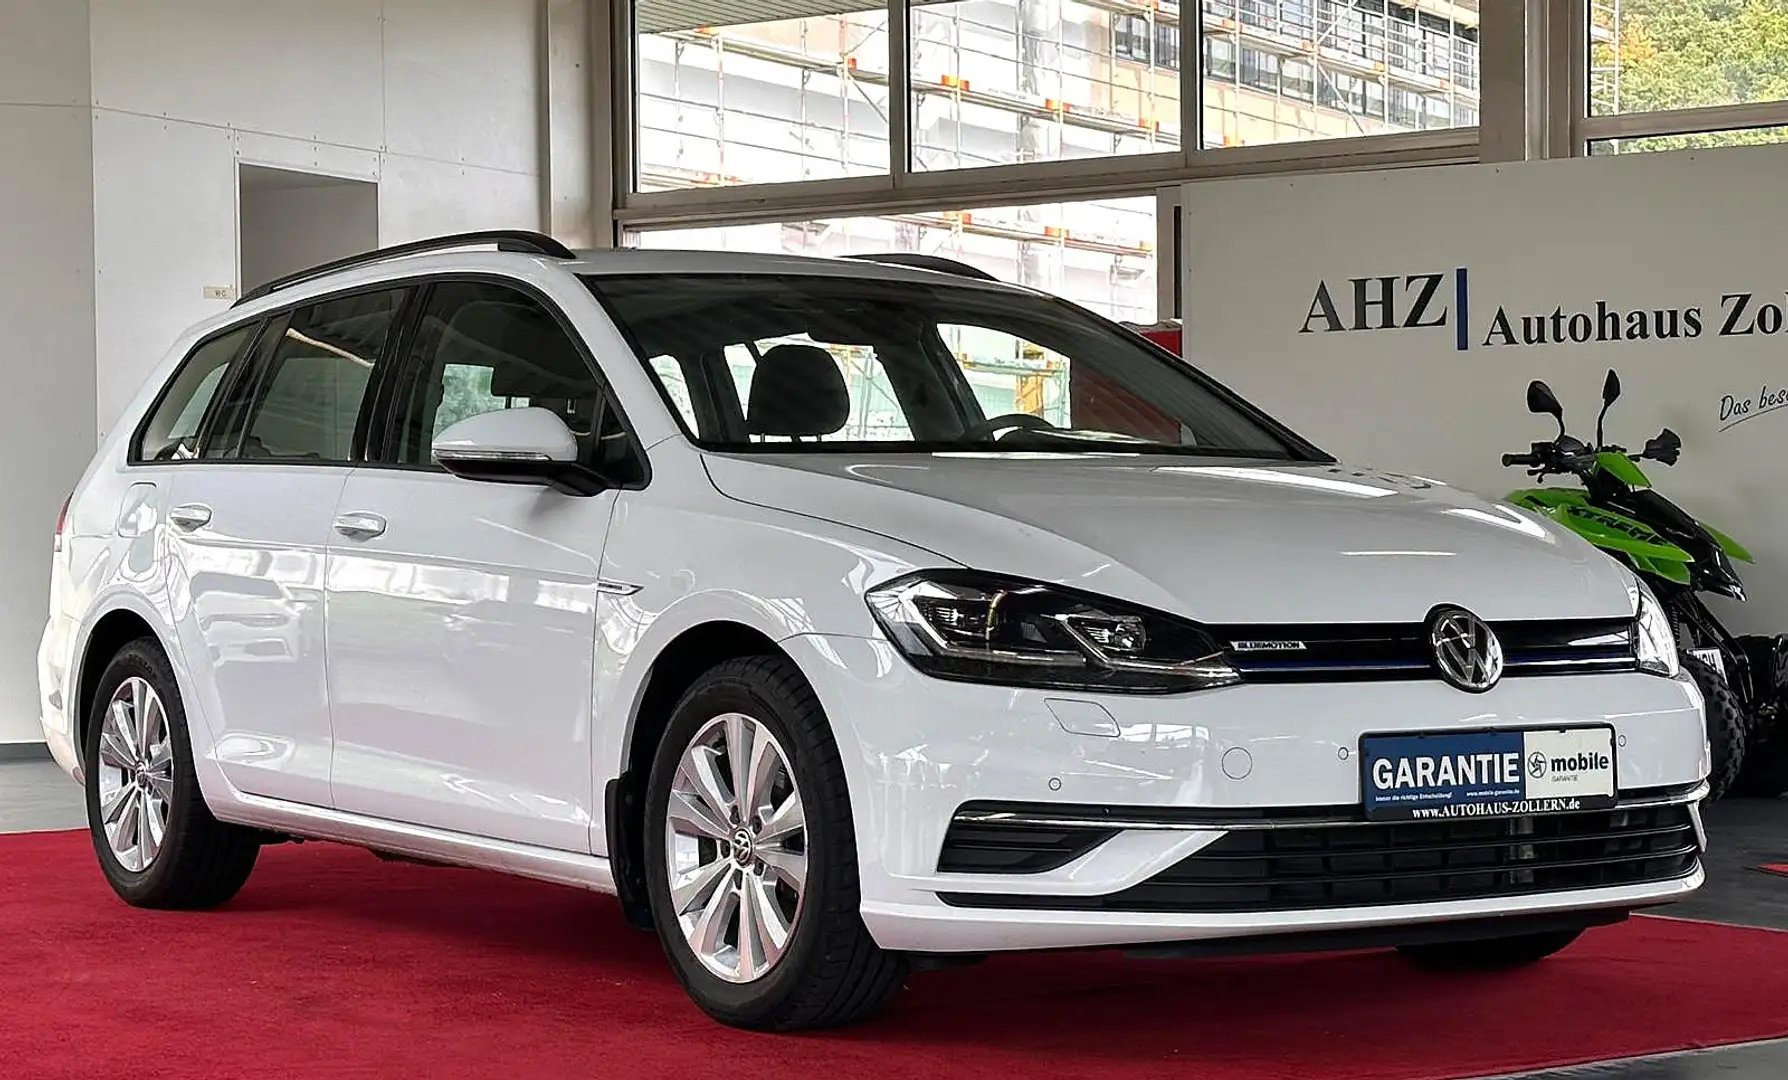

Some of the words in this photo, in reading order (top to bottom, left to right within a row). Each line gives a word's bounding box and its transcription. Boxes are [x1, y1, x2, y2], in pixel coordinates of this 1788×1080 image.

[1298, 273, 1448, 333] AHZ
[1481, 300, 1703, 346] Autohaus
[1718, 292, 1788, 337] Zo
[1719, 395, 1751, 421] Das
[1372, 752, 1520, 790] GARANTIE
[1550, 752, 1609, 772] mobile
[1412, 798, 1581, 818] www.AUTOHAUS-ZOLLERN.de
